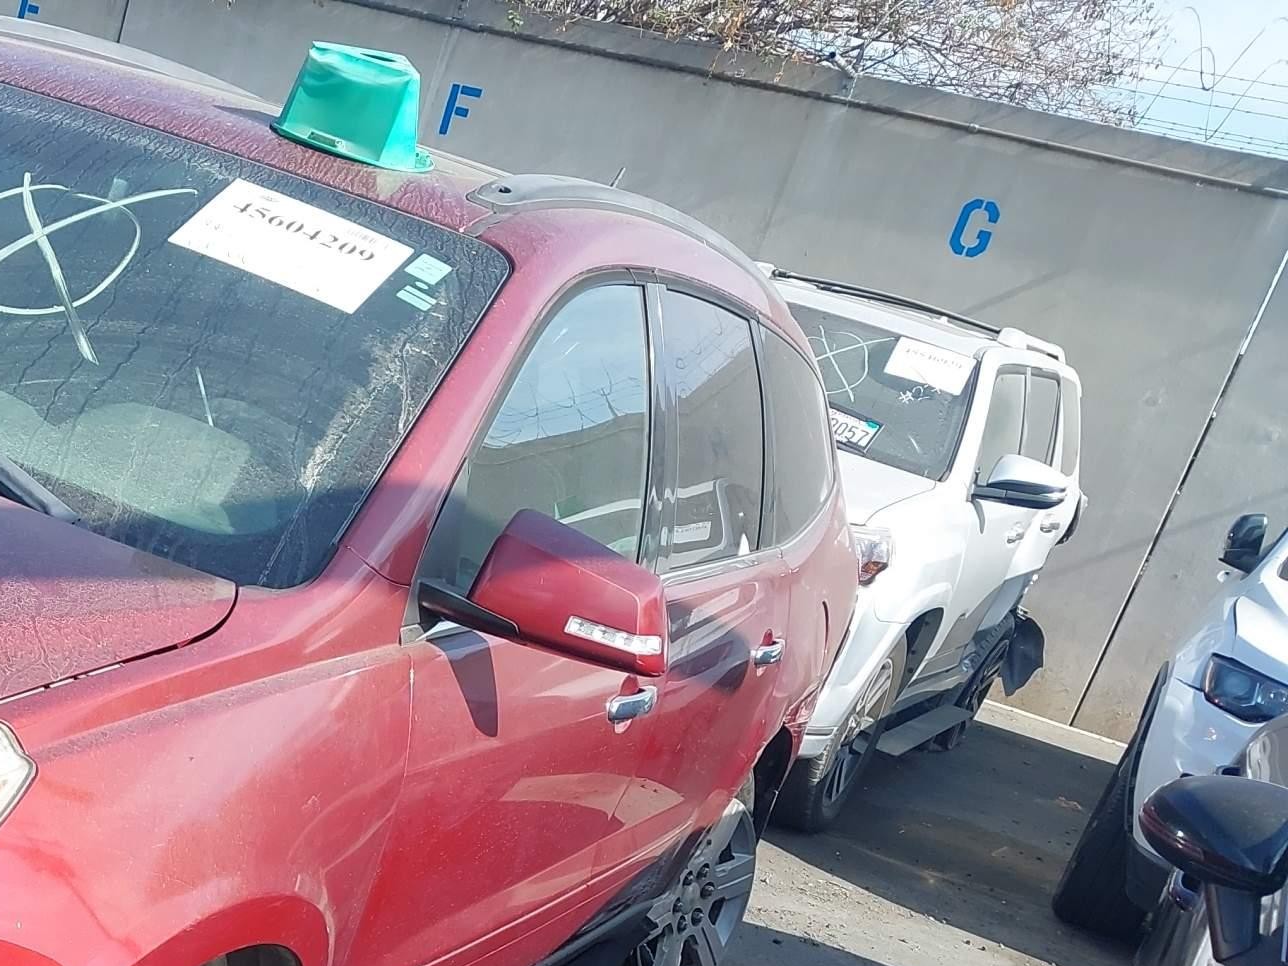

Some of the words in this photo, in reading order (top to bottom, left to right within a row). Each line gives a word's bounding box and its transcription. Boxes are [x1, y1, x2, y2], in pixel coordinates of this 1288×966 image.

[438, 83, 483, 135] F
[232, 201, 376, 262] 45604209
[949, 198, 1000, 258] G
